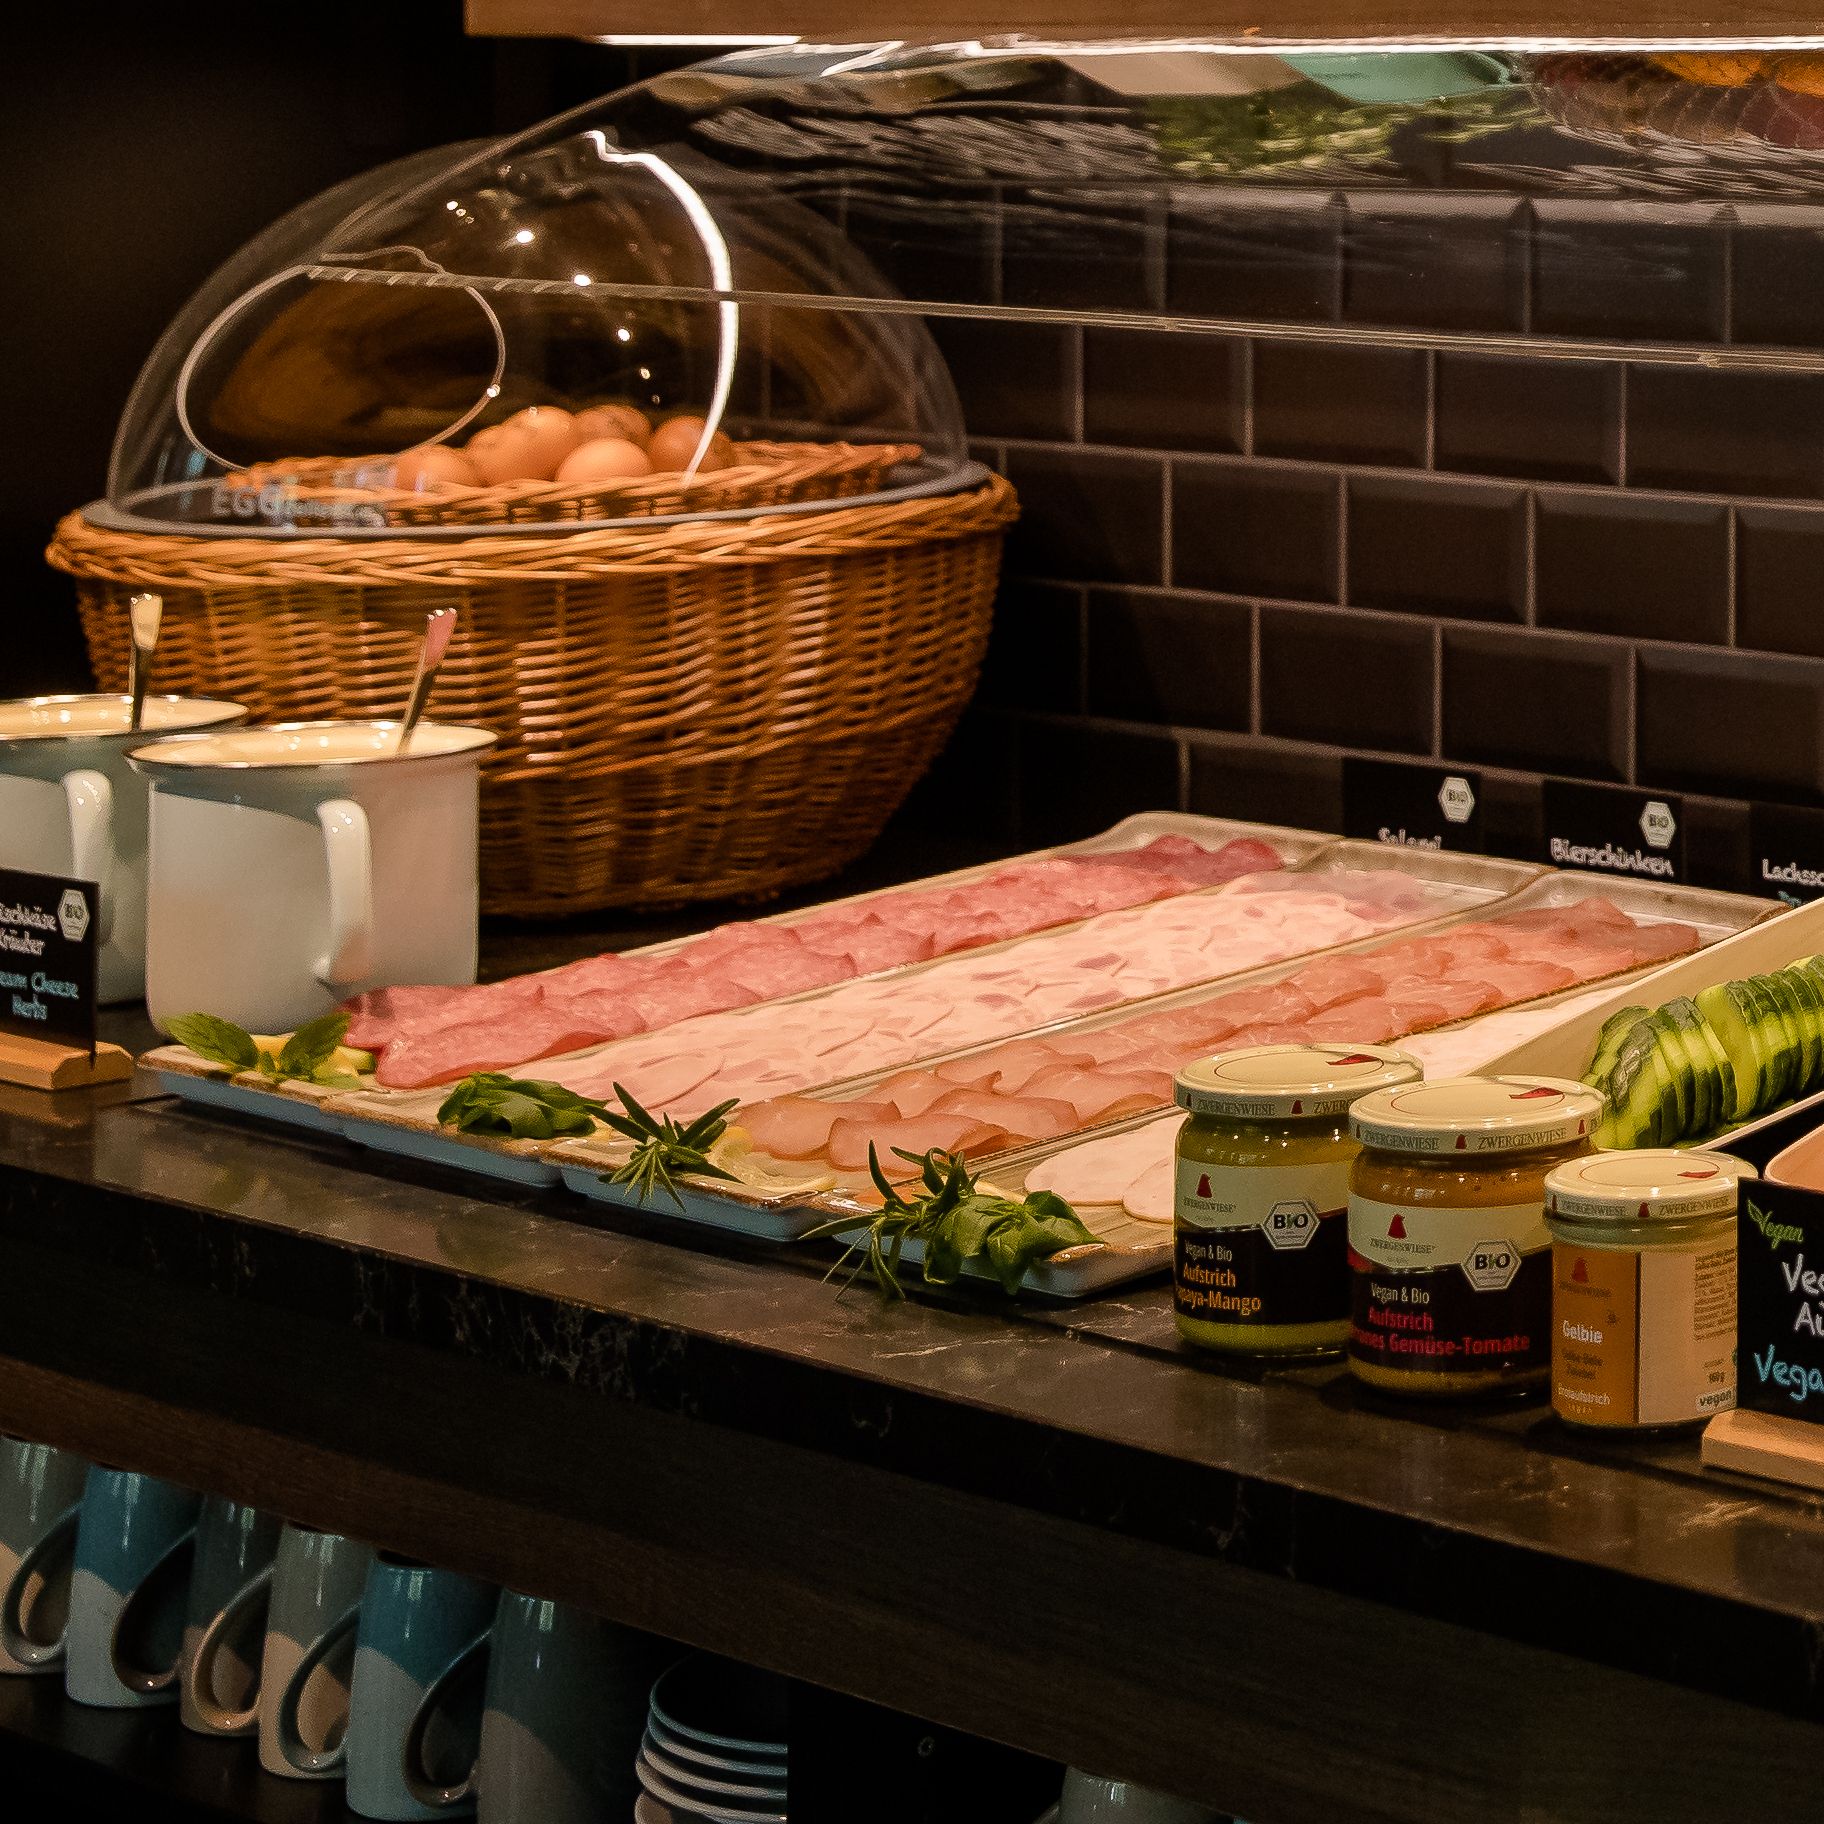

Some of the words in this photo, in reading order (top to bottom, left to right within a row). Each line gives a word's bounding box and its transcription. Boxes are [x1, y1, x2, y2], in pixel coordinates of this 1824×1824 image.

[1476, 1127, 1568, 1151] ZWERGENWIESE
[1748, 1199, 1804, 1249] Vegan
[1183, 1261, 1237, 1288] Aufstrich
[1371, 1282, 1398, 1305] Vegan
[1411, 1286, 1430, 1305] Bio
[1367, 1306, 1435, 1331] Aufstrich
[1388, 1332, 1531, 1356] Gemüse-Tomate
[1561, 1319, 1604, 1345] Gelbie
[1699, 1388, 1732, 1409] vegan
